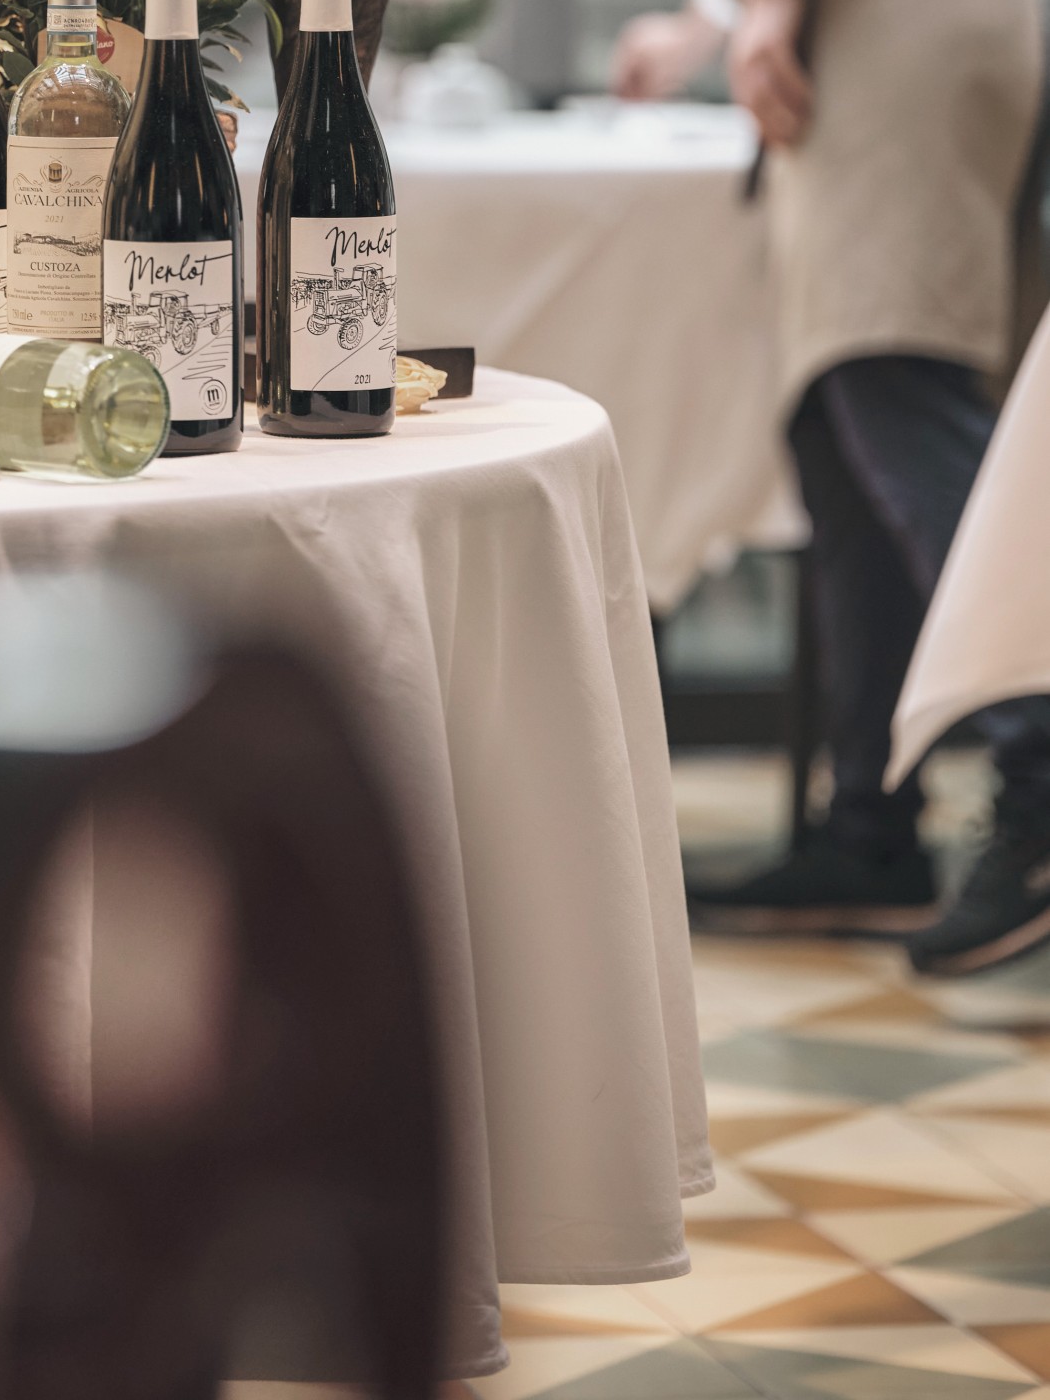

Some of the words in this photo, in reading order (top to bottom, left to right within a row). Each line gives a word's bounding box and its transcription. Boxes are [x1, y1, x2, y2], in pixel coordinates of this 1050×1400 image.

[14, 193, 103, 207] CAVALCHINA
[45, 215, 64, 223] 2021
[325, 226, 396, 267] Merlot
[30, 261, 80, 272] CUSTOZA
[124, 250, 233, 291] Merlot
[354, 374, 371, 385] 2021
